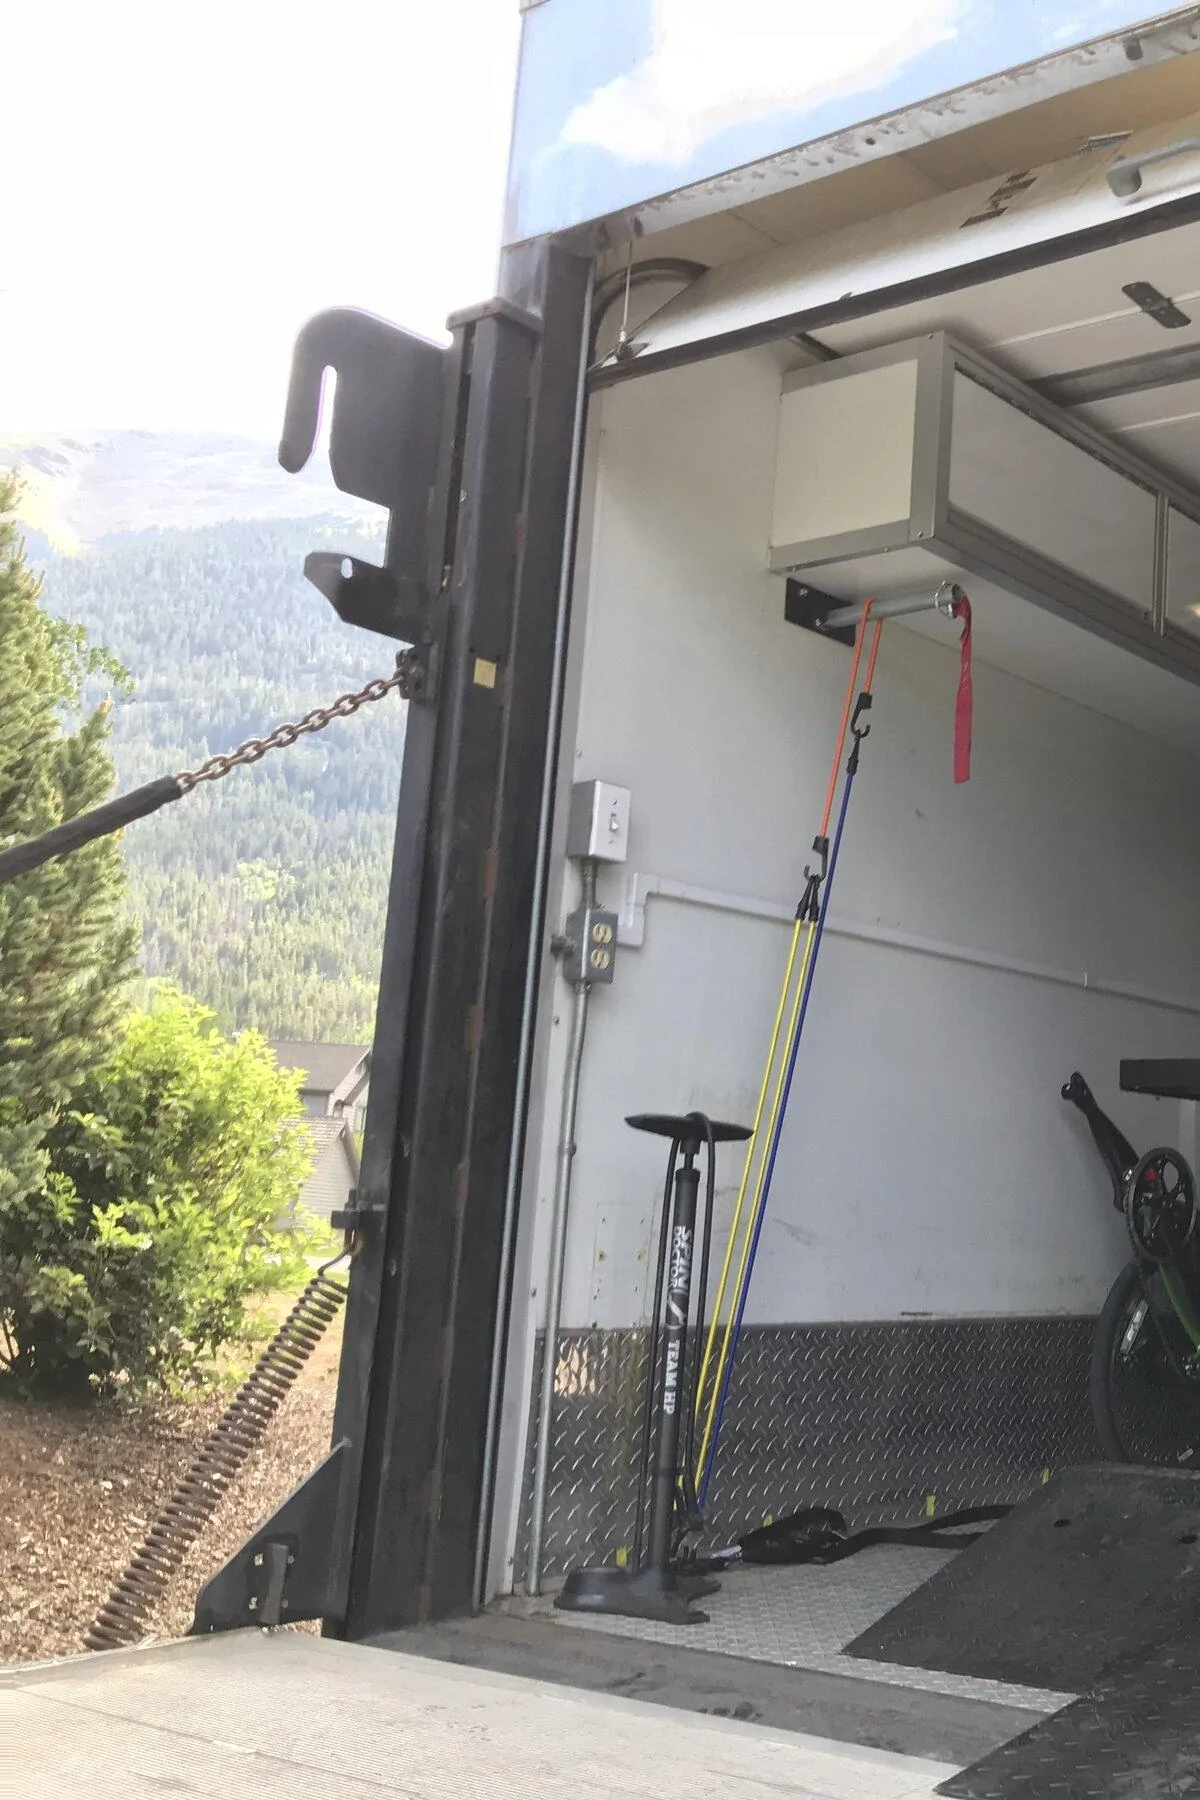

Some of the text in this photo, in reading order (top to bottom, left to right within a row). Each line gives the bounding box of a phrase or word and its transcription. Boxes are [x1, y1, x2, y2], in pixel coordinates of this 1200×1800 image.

[669, 1226, 683, 1288] DOCTOR
[677, 1226, 693, 1289] SPIN
[663, 1340, 680, 1415] TEAM HP
